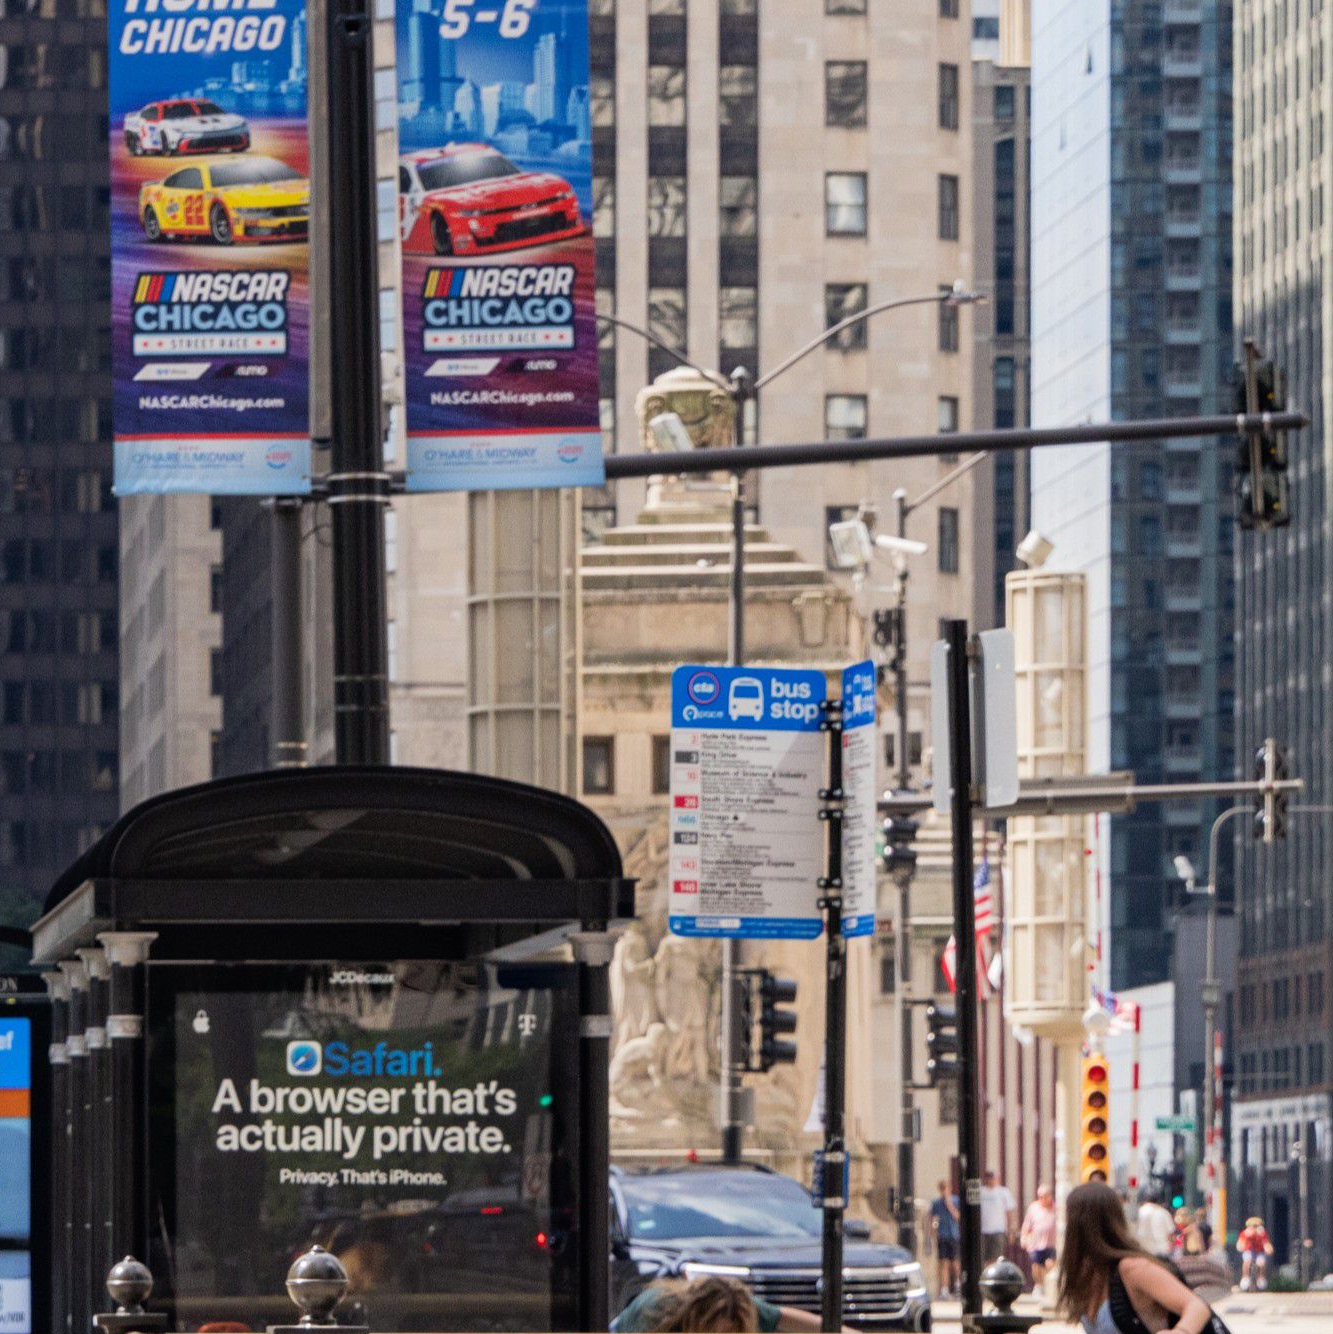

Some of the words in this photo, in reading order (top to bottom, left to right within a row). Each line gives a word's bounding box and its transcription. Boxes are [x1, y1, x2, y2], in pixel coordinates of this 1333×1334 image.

[439, 0, 537, 39] 5-6
[119, 15, 286, 54] CHICAGO
[171, 272, 289, 302] NASCAR
[460, 266, 574, 297] NASCAR
[135, 303, 285, 330] CHICAGO
[425, 298, 572, 325] CHICAGO
[171, 339, 215, 349] STREET
[219, 338, 248, 348] RACE
[460, 334, 504, 345] STREET
[508, 333, 536, 343] RACE
[139, 394, 285, 411] NASCARChicago.com
[430, 390, 574, 406] NASCARChicago.com
[693, 682, 714, 693] cta
[771, 678, 811, 698] bus
[770, 699, 819, 724] stop
[328, 971, 395, 985] JCDecaux
[324, 1041, 442, 1076] Safari.
[212, 1078, 242, 1113] A
[250, 1079, 406, 1115] browser
[411, 1080, 517, 1115] that's
[216, 1117, 366, 1160] actually
[373, 1117, 511, 1160] private.
[280, 1169, 339, 1187] Privacy.
[340, 1169, 387, 1184] That's
[389, 1170, 447, 1185] iPhone.
